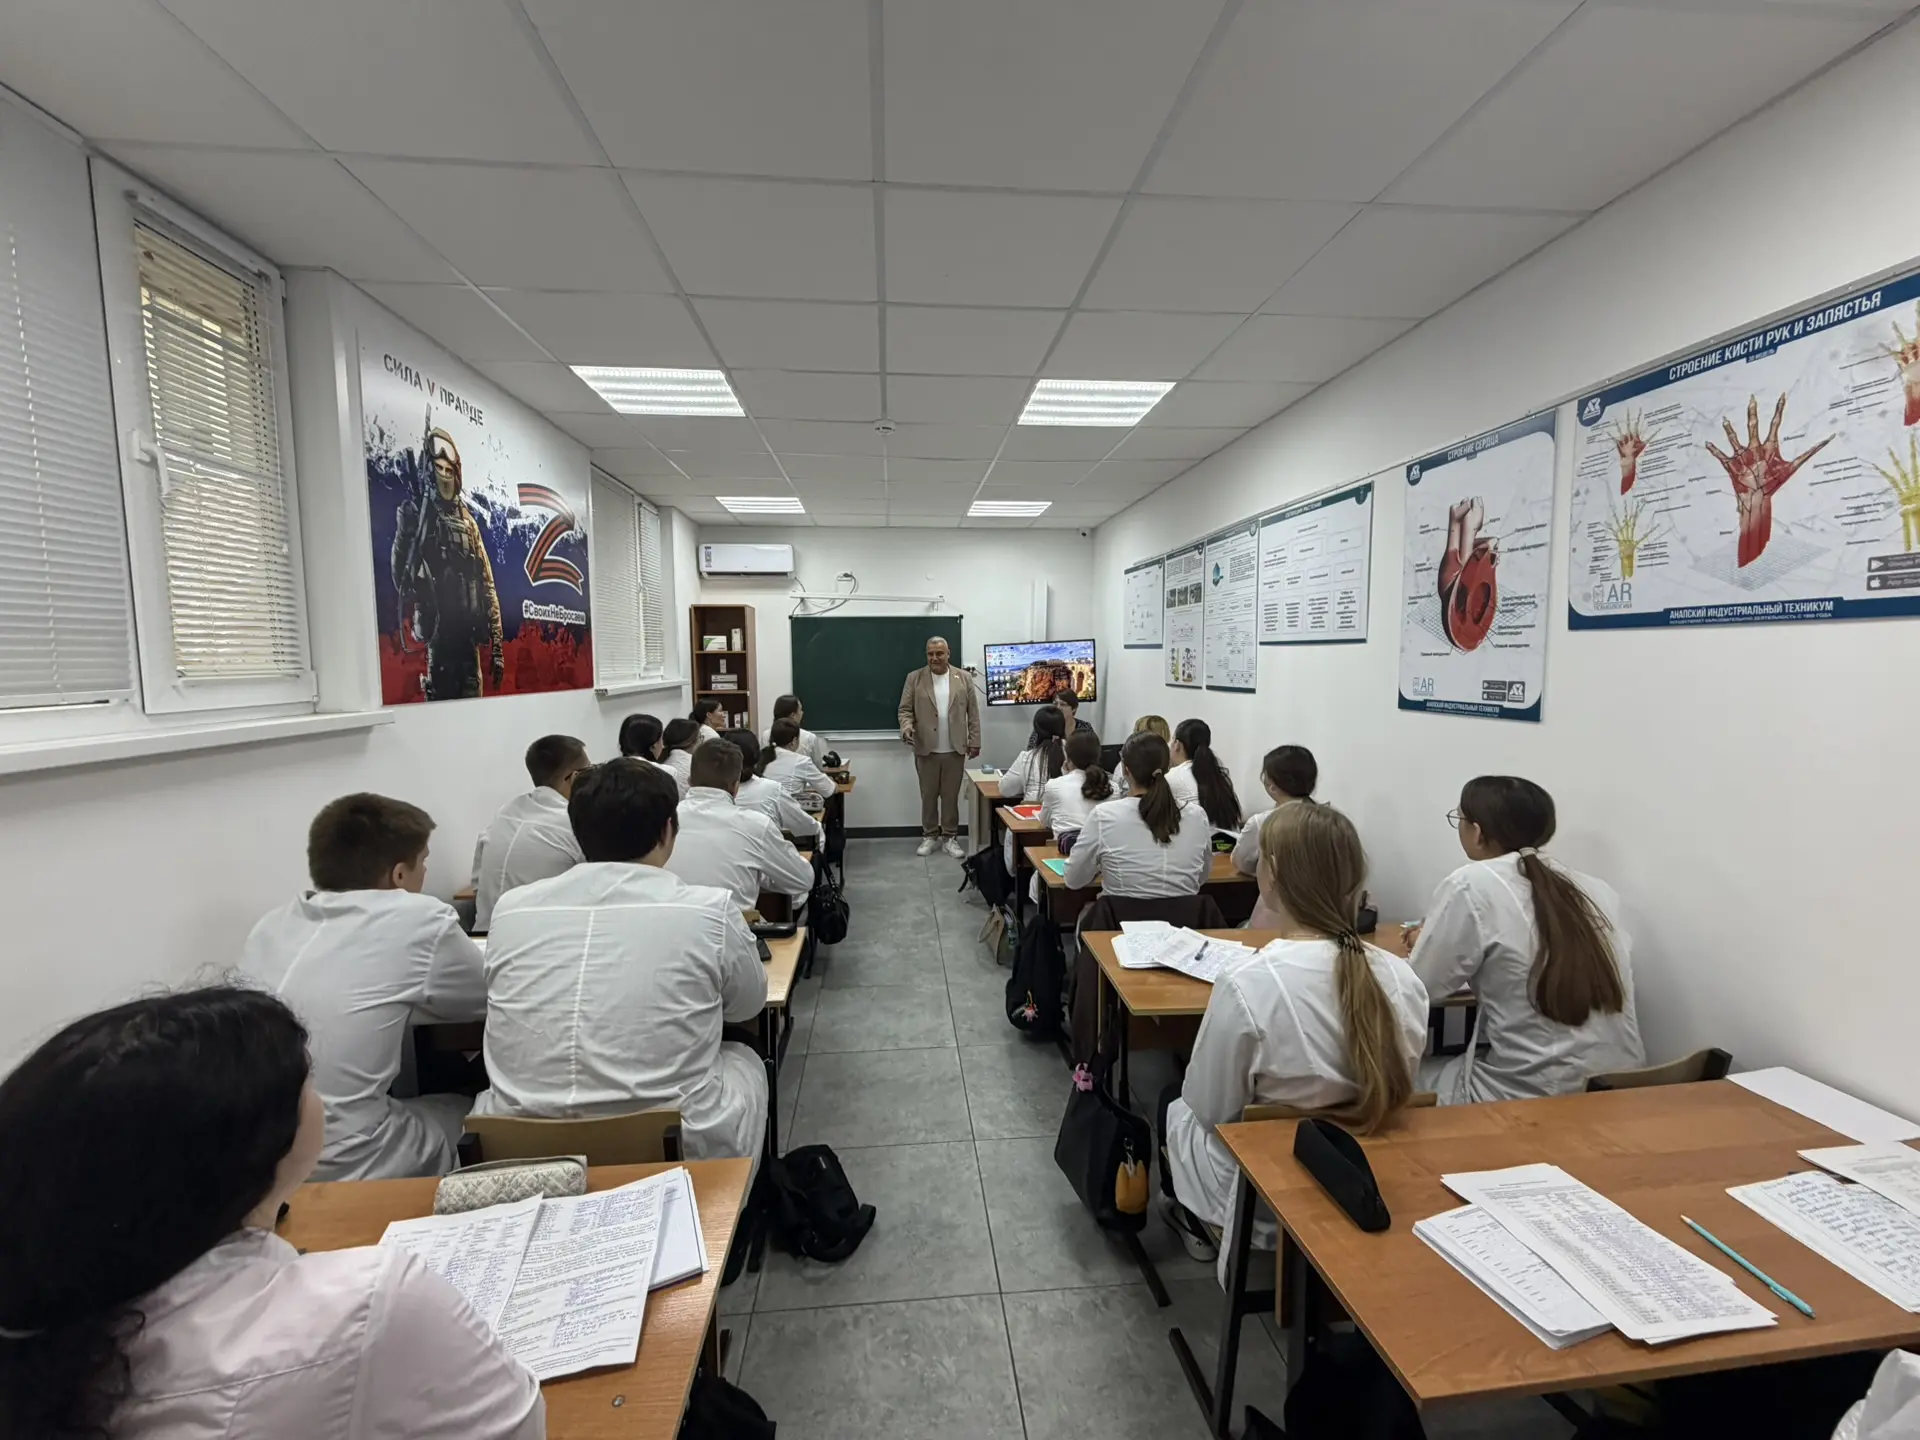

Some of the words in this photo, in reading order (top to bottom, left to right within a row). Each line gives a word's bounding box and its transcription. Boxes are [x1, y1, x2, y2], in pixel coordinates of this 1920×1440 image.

[1669, 349, 1722, 381] СТРОЕНИЕ
[1724, 335, 1764, 361] КИСТИ
[1766, 326, 1791, 347] РУК
[1794, 319, 1804, 336] И
[1806, 290, 1882, 332] ЗАПЯСТЬЯ
[383, 353, 423, 392] СИЛА
[426, 377, 435, 397] V
[439, 386, 484, 427] ПРАВДЕ
[1447, 442, 1474, 461] СТРОЕНИЕ
[1475, 433, 1499, 450] СЕРДЦА
[1607, 582, 1632, 602] AR
[523, 600, 586, 625] #СвоихНеБросаем
[1669, 607, 1706, 619] АНАПСКИЙ
[1707, 602, 1782, 617] ИНДУСТРИАЛЬНЫЙ
[1784, 600, 1834, 613] ТЕХНИКУМ
[1420, 677, 1435, 692] AR
